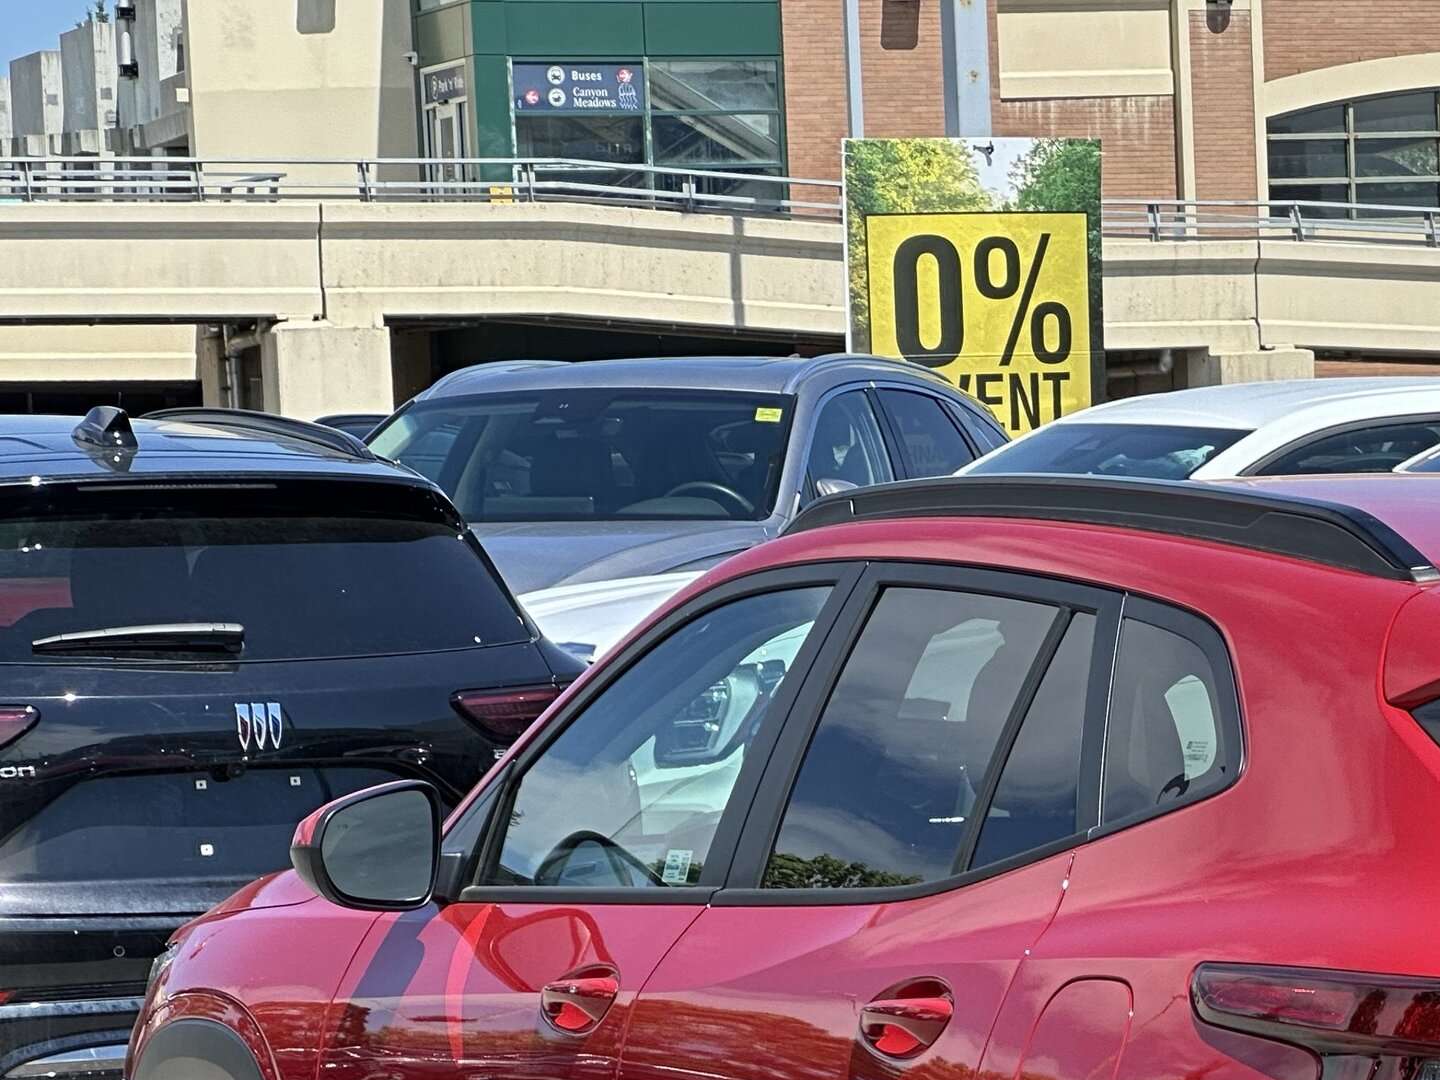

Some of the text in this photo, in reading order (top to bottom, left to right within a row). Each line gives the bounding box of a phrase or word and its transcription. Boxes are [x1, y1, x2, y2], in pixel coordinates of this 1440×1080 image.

[571, 70, 602, 81] Buses
[573, 87, 608, 98] Canyon
[573, 97, 617, 108] Meadows
[893, 232, 1072, 368] 0%
